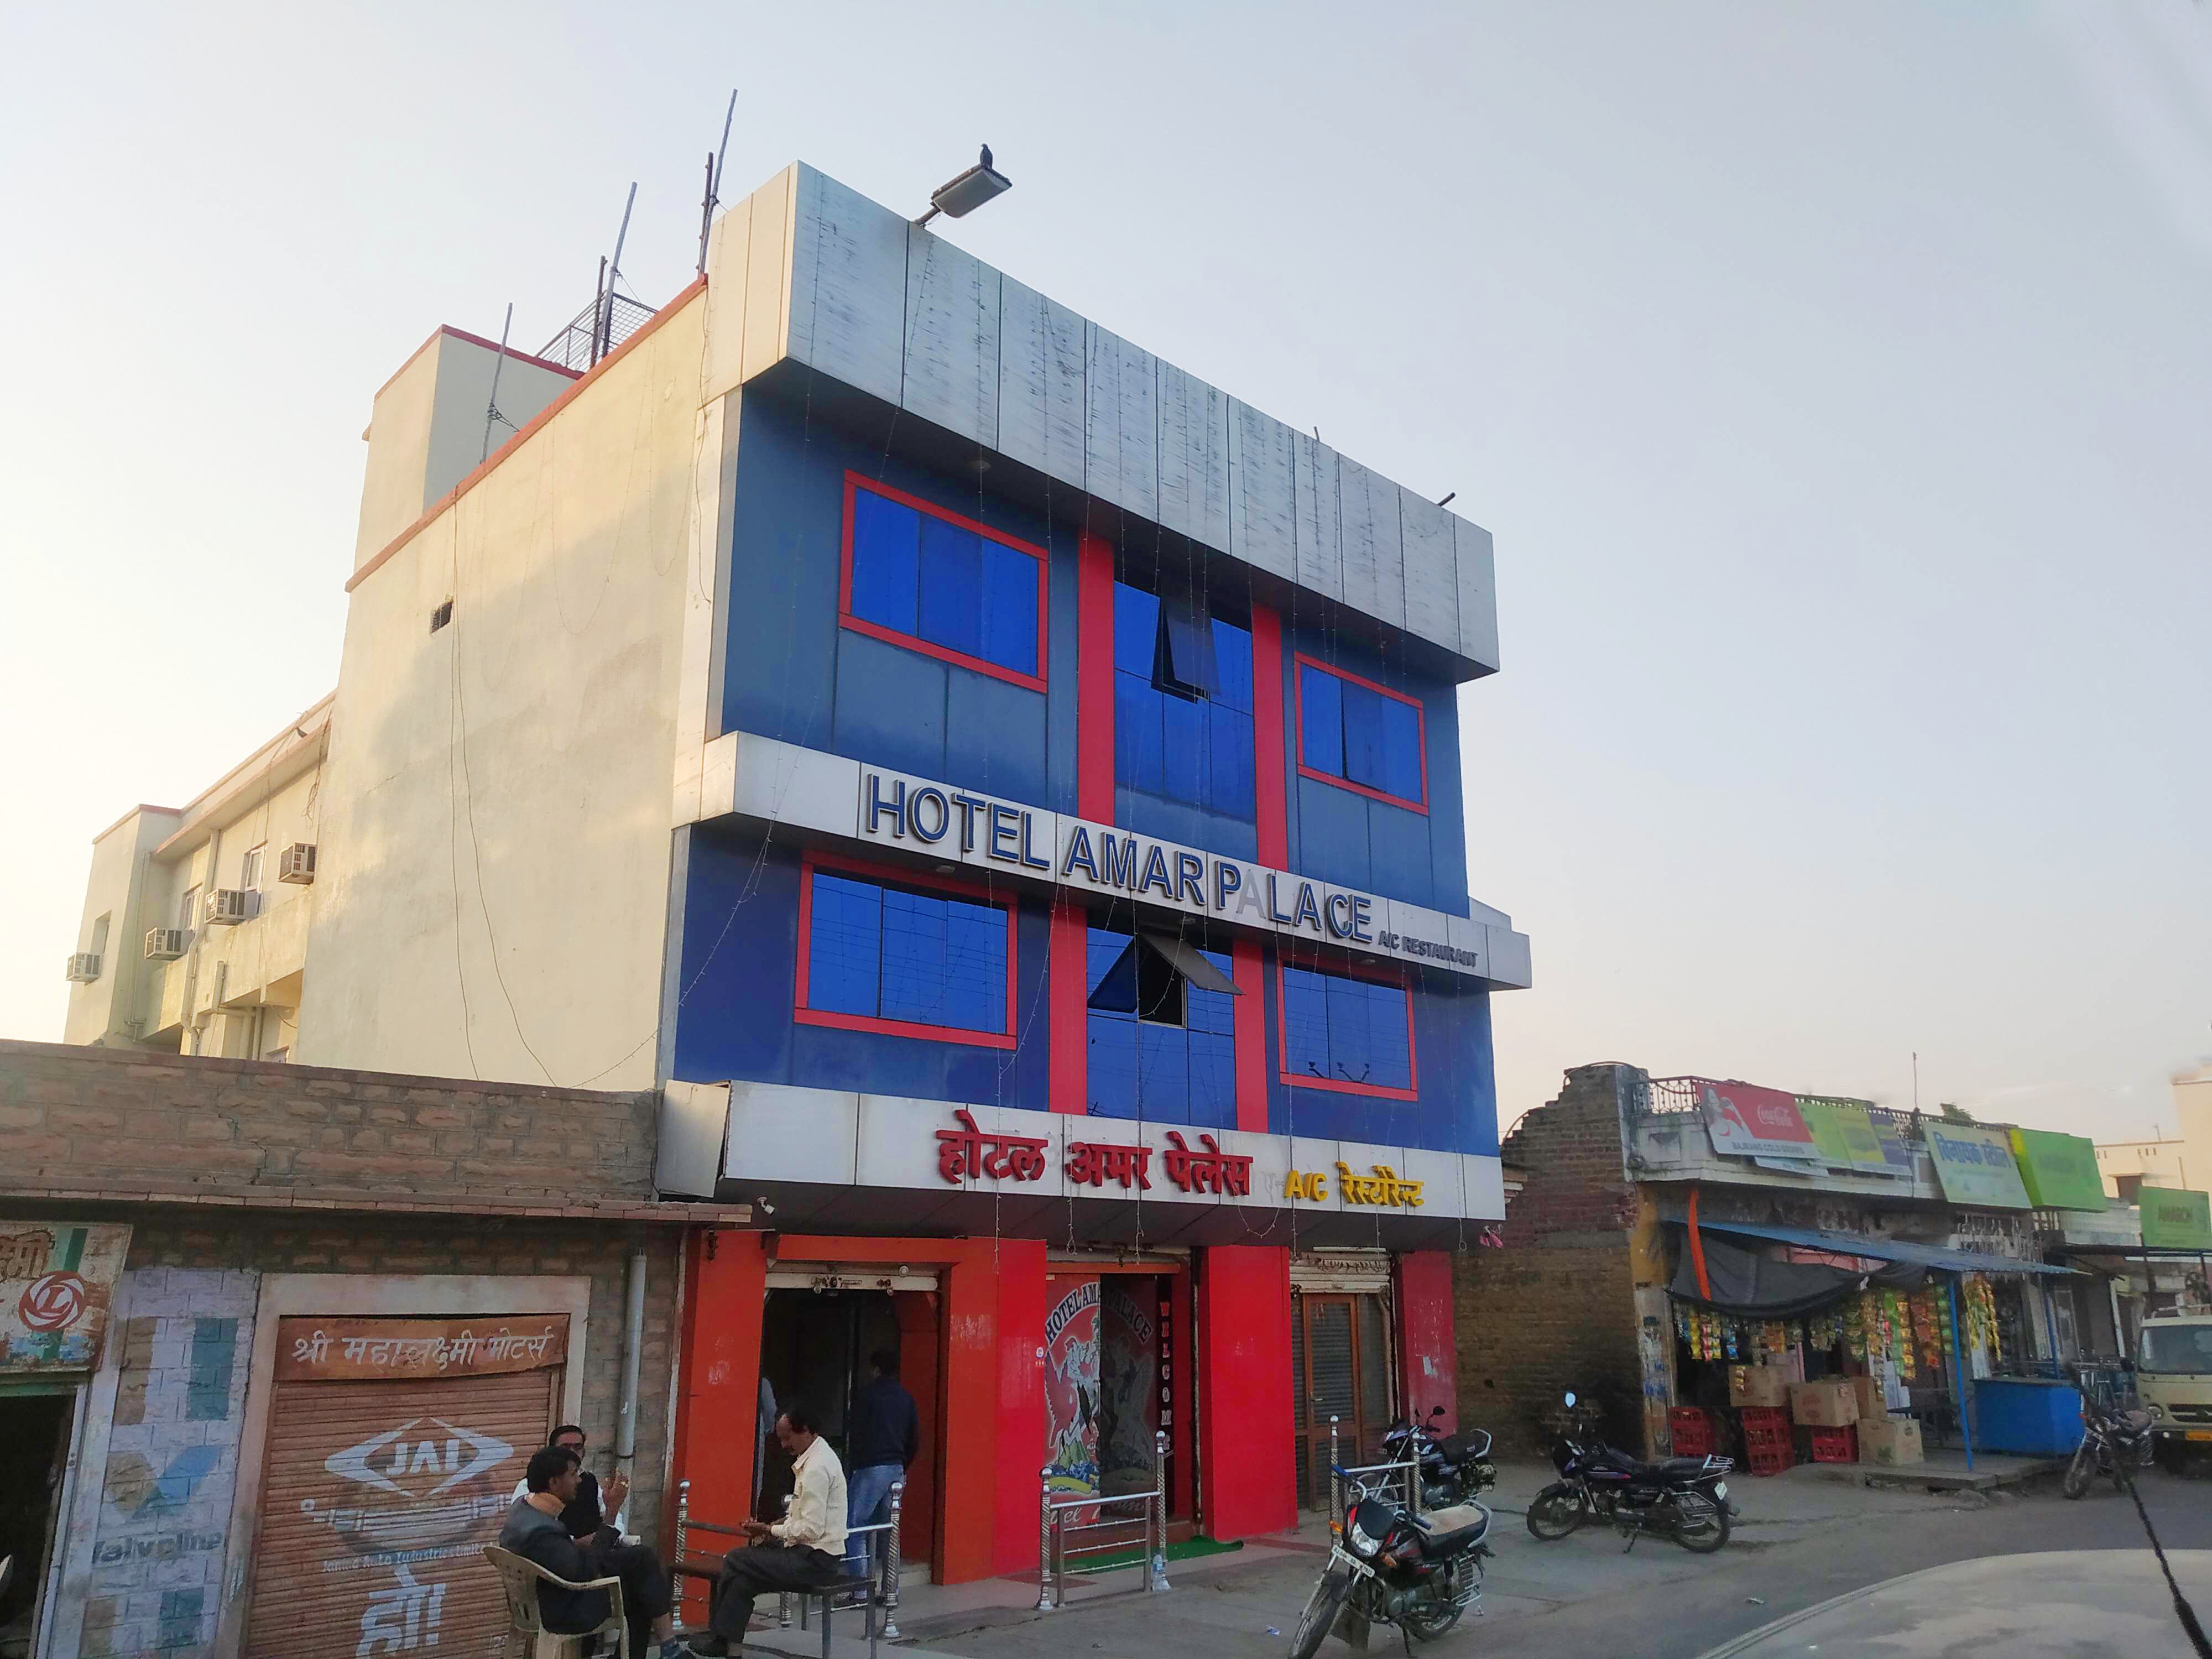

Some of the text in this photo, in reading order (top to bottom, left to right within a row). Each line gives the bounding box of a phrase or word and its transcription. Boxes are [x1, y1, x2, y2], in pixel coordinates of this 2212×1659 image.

[867, 773, 1373, 943] HOTEL AMAR PALACE
[1401, 936, 1479, 967] RESTAURANT
[936, 1109, 1254, 1196] होटल अमर पेलेस
[1764, 1143, 1781, 1152] COLD
[1045, 1289, 1082, 1345] HOTEL
[291, 1328, 335, 1365] श्री
[488, 1325, 555, 1364] मोटर्स
[385, 1438, 461, 1477] JAI
